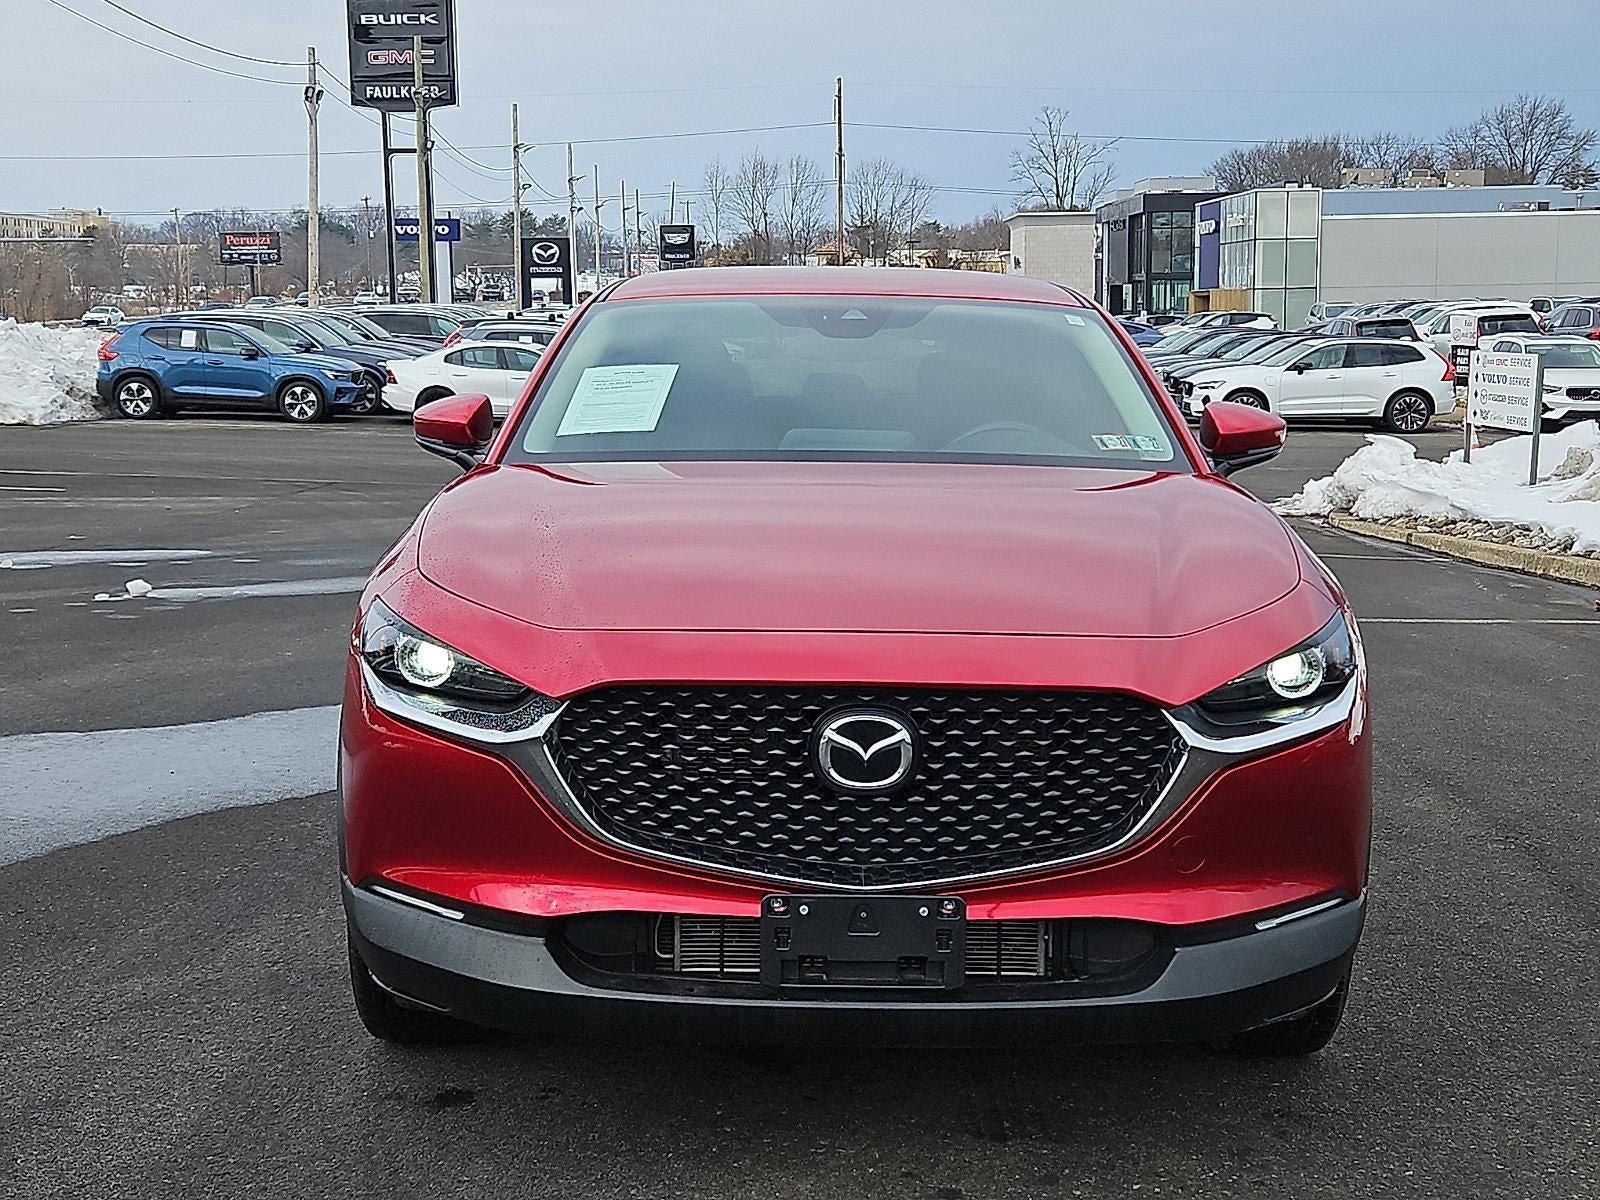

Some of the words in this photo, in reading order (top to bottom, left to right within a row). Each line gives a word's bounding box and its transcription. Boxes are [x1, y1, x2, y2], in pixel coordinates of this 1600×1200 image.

[360, 13, 439, 25] BUICK
[367, 49, 435, 65] GMC
[394, 224, 450, 235] VOO
[225, 234, 272, 245] Peruzzi
[1510, 357, 1532, 369] SERVICE
[1481, 372, 1508, 385] VOLVO
[1509, 376, 1531, 387] SERVICE
[1507, 395, 1529, 407] SERVICE
[1506, 415, 1528, 427] SERVICE
